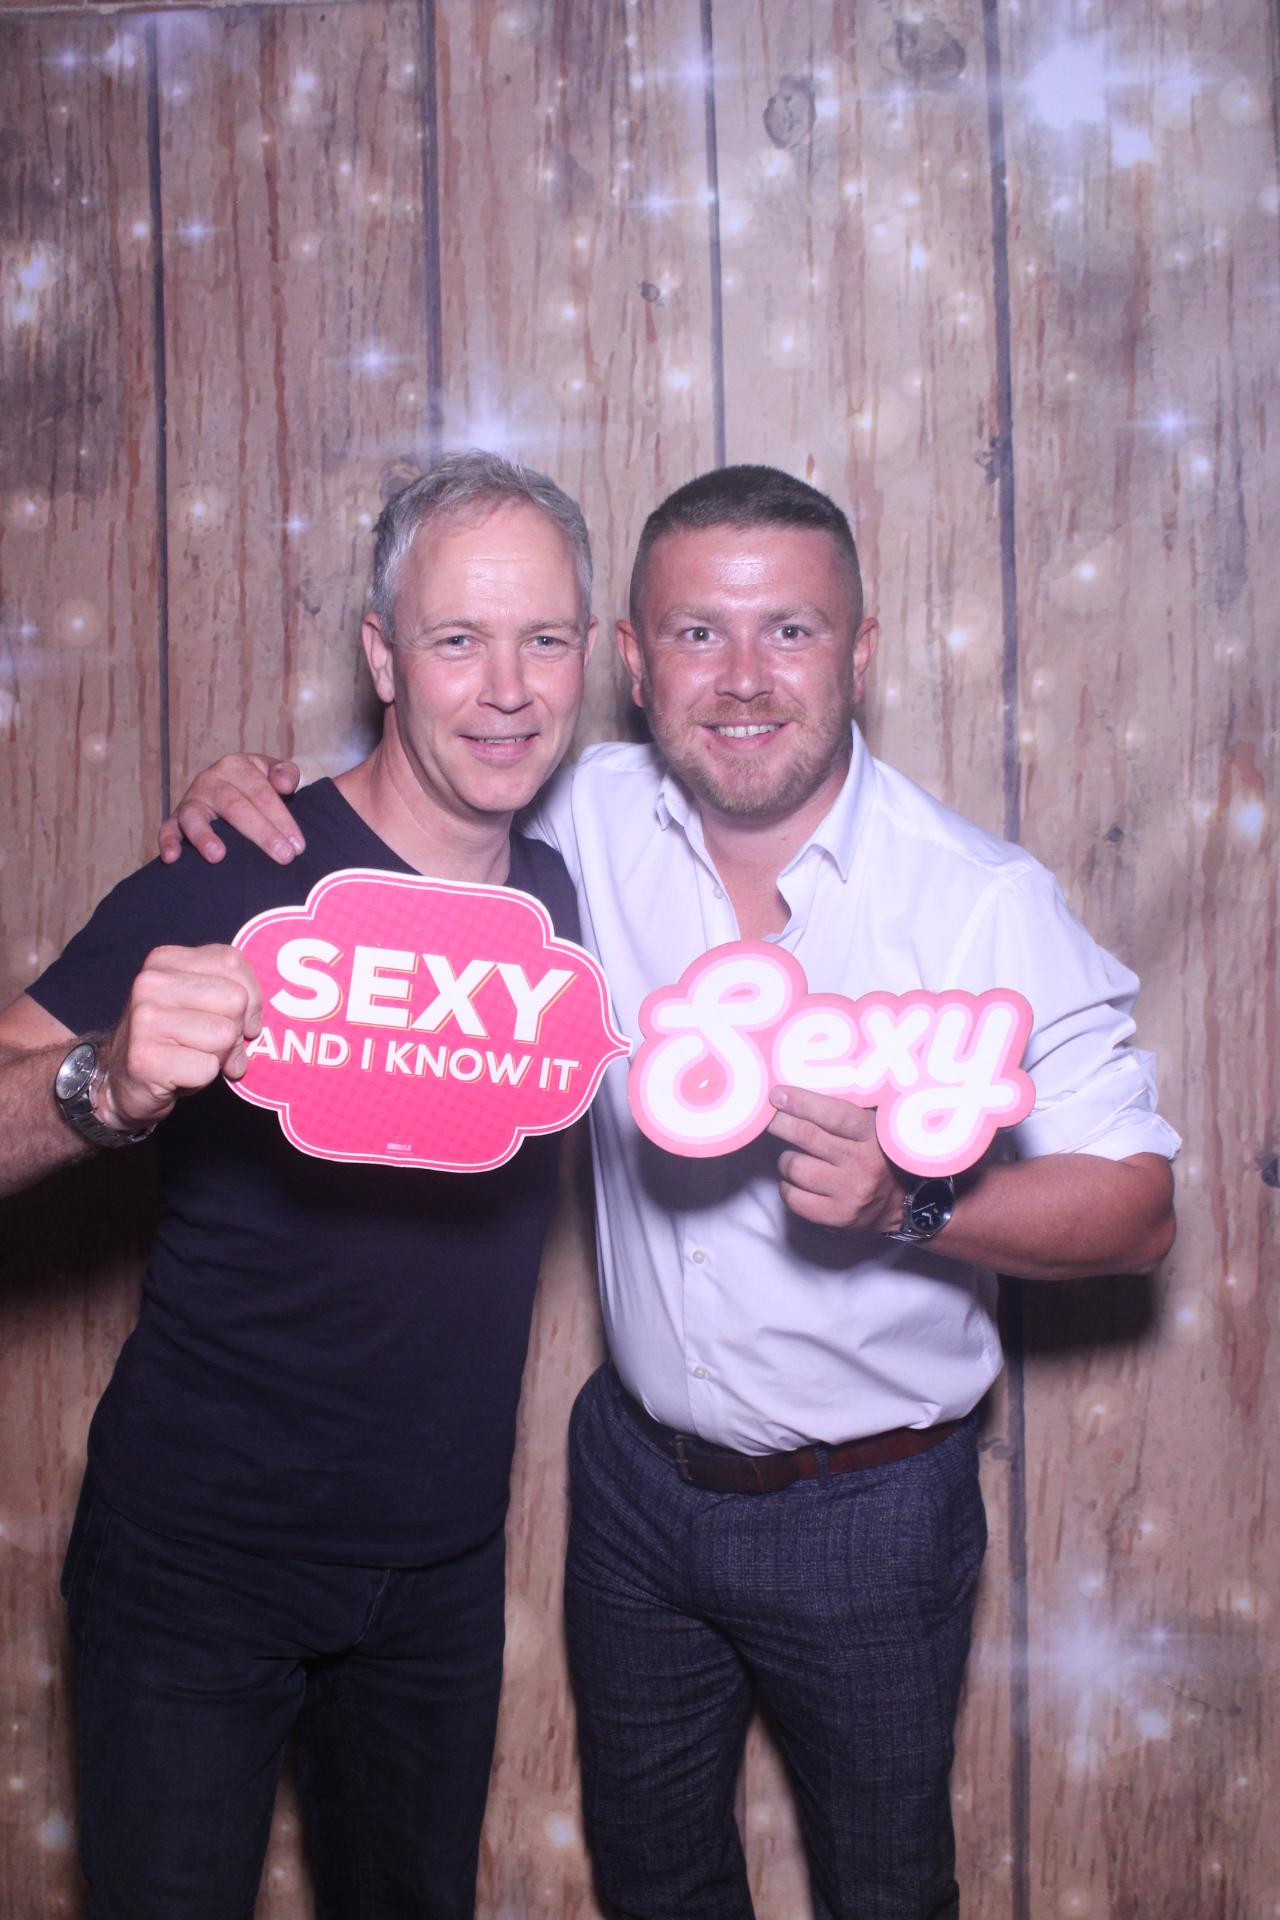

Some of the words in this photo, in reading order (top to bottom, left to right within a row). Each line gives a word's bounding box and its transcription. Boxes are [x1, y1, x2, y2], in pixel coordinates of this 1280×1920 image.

[269, 937, 577, 1044] SEXY
[246, 1027, 349, 1067] AND
[360, 1038, 374, 1072] I
[384, 1042, 533, 1087] KNOW
[538, 1057, 581, 1093] IT
[645, 957, 1015, 1158] Sexy
